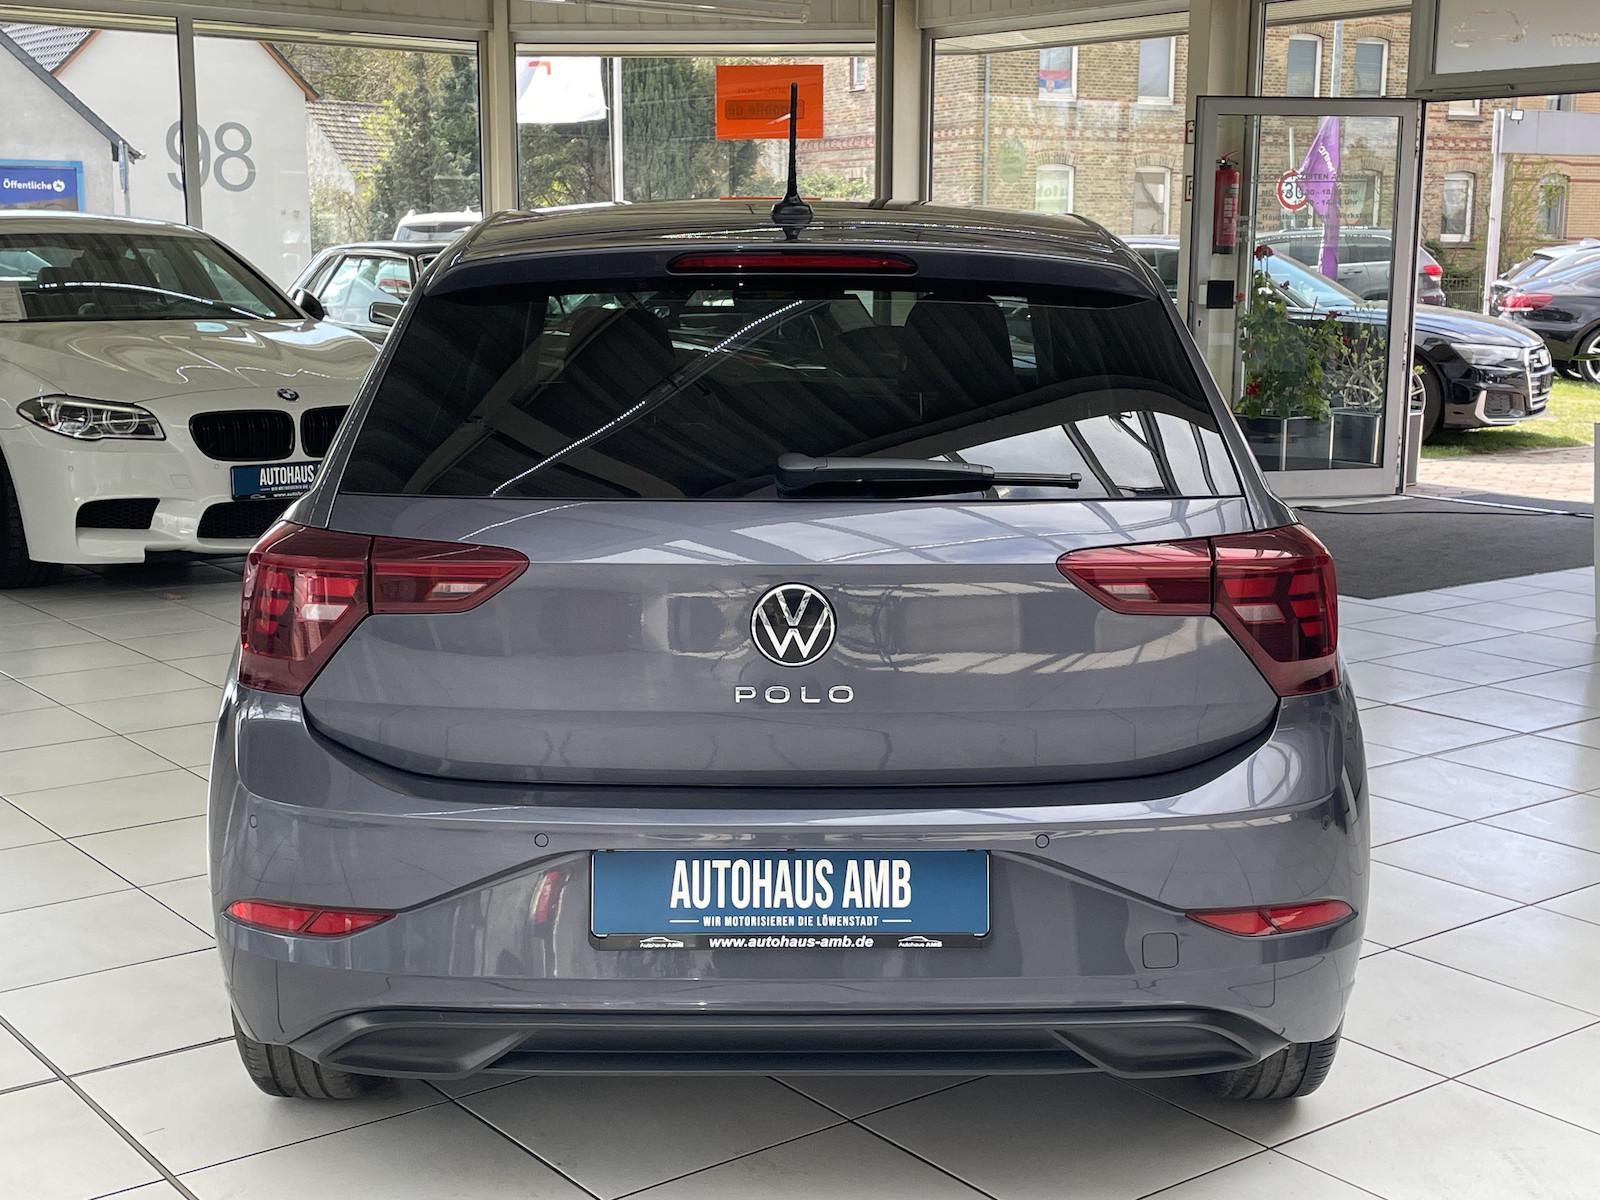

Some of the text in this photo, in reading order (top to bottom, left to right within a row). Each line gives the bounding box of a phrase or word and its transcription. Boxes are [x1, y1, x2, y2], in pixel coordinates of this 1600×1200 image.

[165, 119, 256, 192] 98
[3, 177, 52, 190] Öffentliche
[260, 465, 314, 486] AUTOHAUS
[733, 685, 855, 704] POLO
[669, 858, 913, 910] AUTOHAUS AMB
[702, 914, 879, 927] WIR MOTORISIEREN DIE LÖWENSTADT
[708, 934, 875, 949] www.autohaus-amb.de
